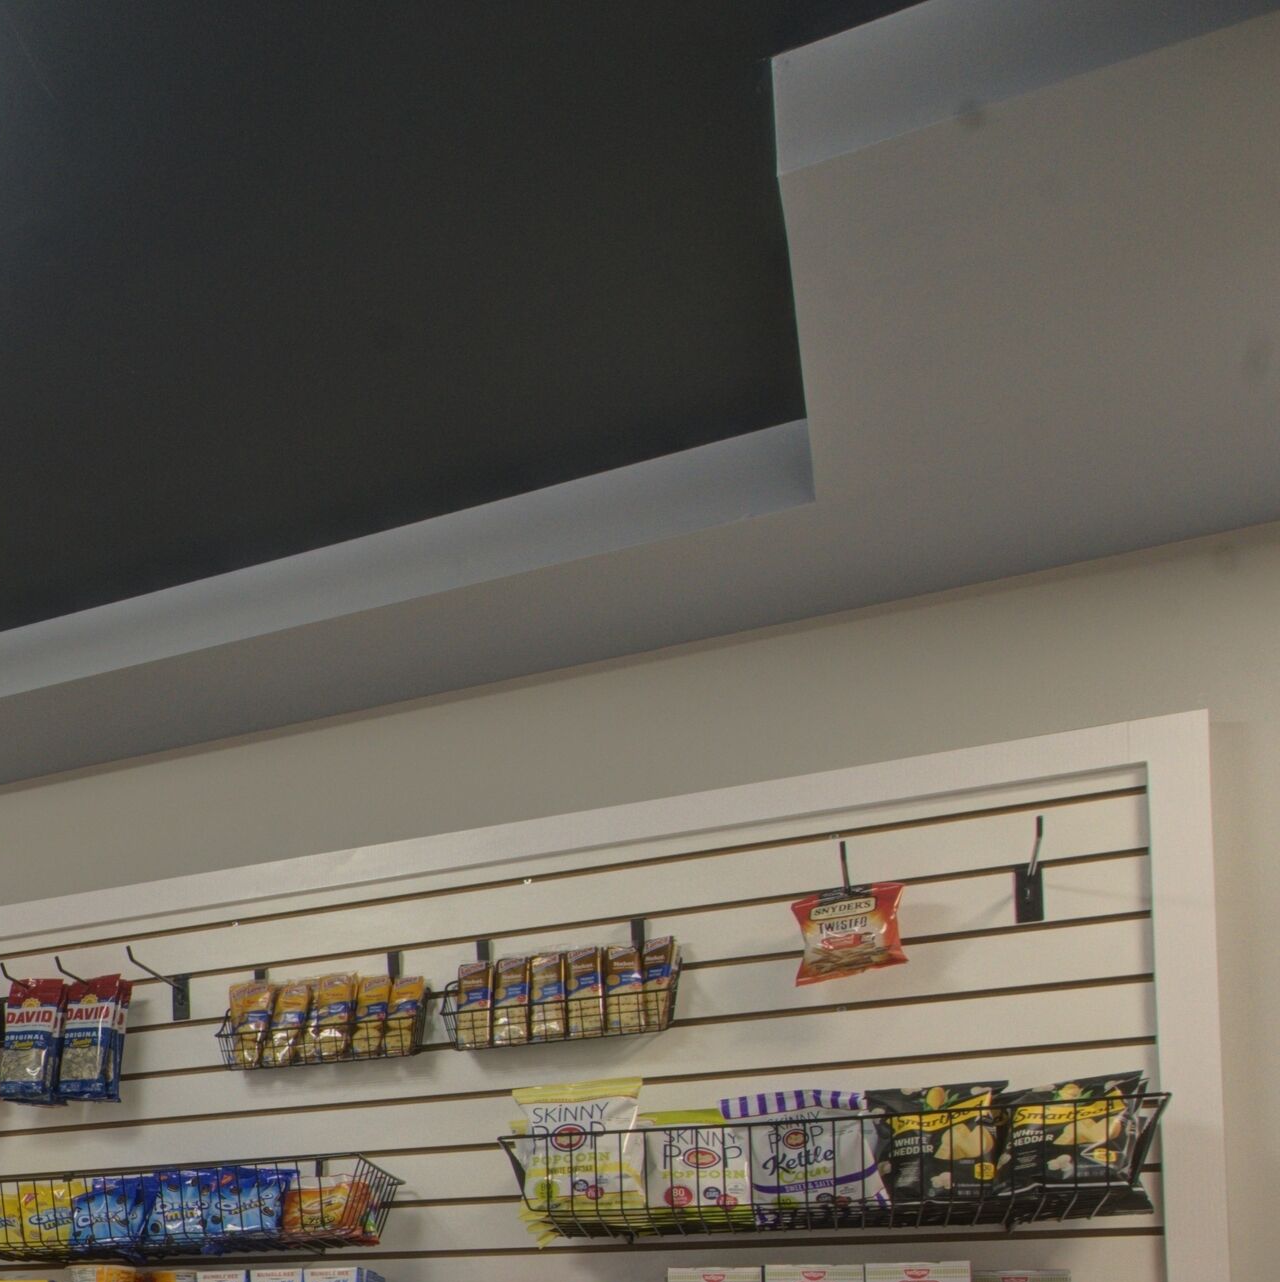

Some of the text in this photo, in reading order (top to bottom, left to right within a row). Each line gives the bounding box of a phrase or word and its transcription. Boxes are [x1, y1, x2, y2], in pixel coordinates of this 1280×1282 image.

[813, 900, 871, 916] SNYDER'S
[818, 916, 868, 934] TWISTED
[6, 1009, 53, 1024] DAVID
[65, 1004, 110, 1020] DAVID
[5, 1032, 44, 1041] ORIGINAL
[532, 1101, 609, 1124] SKINNY
[1015, 1098, 1115, 1123] Smartfood
[531, 1121, 607, 1155] POP
[767, 1125, 824, 1155] POP
[894, 1136, 928, 1148] WHITE
[532, 1152, 611, 1166] POPCORN
[662, 1144, 743, 1170] POP
[889, 1145, 934, 1158] HEDDR
[762, 1146, 836, 1176] Kettle
[661, 1169, 747, 1180] POPCORN
[779, 1166, 831, 1184] Corn
